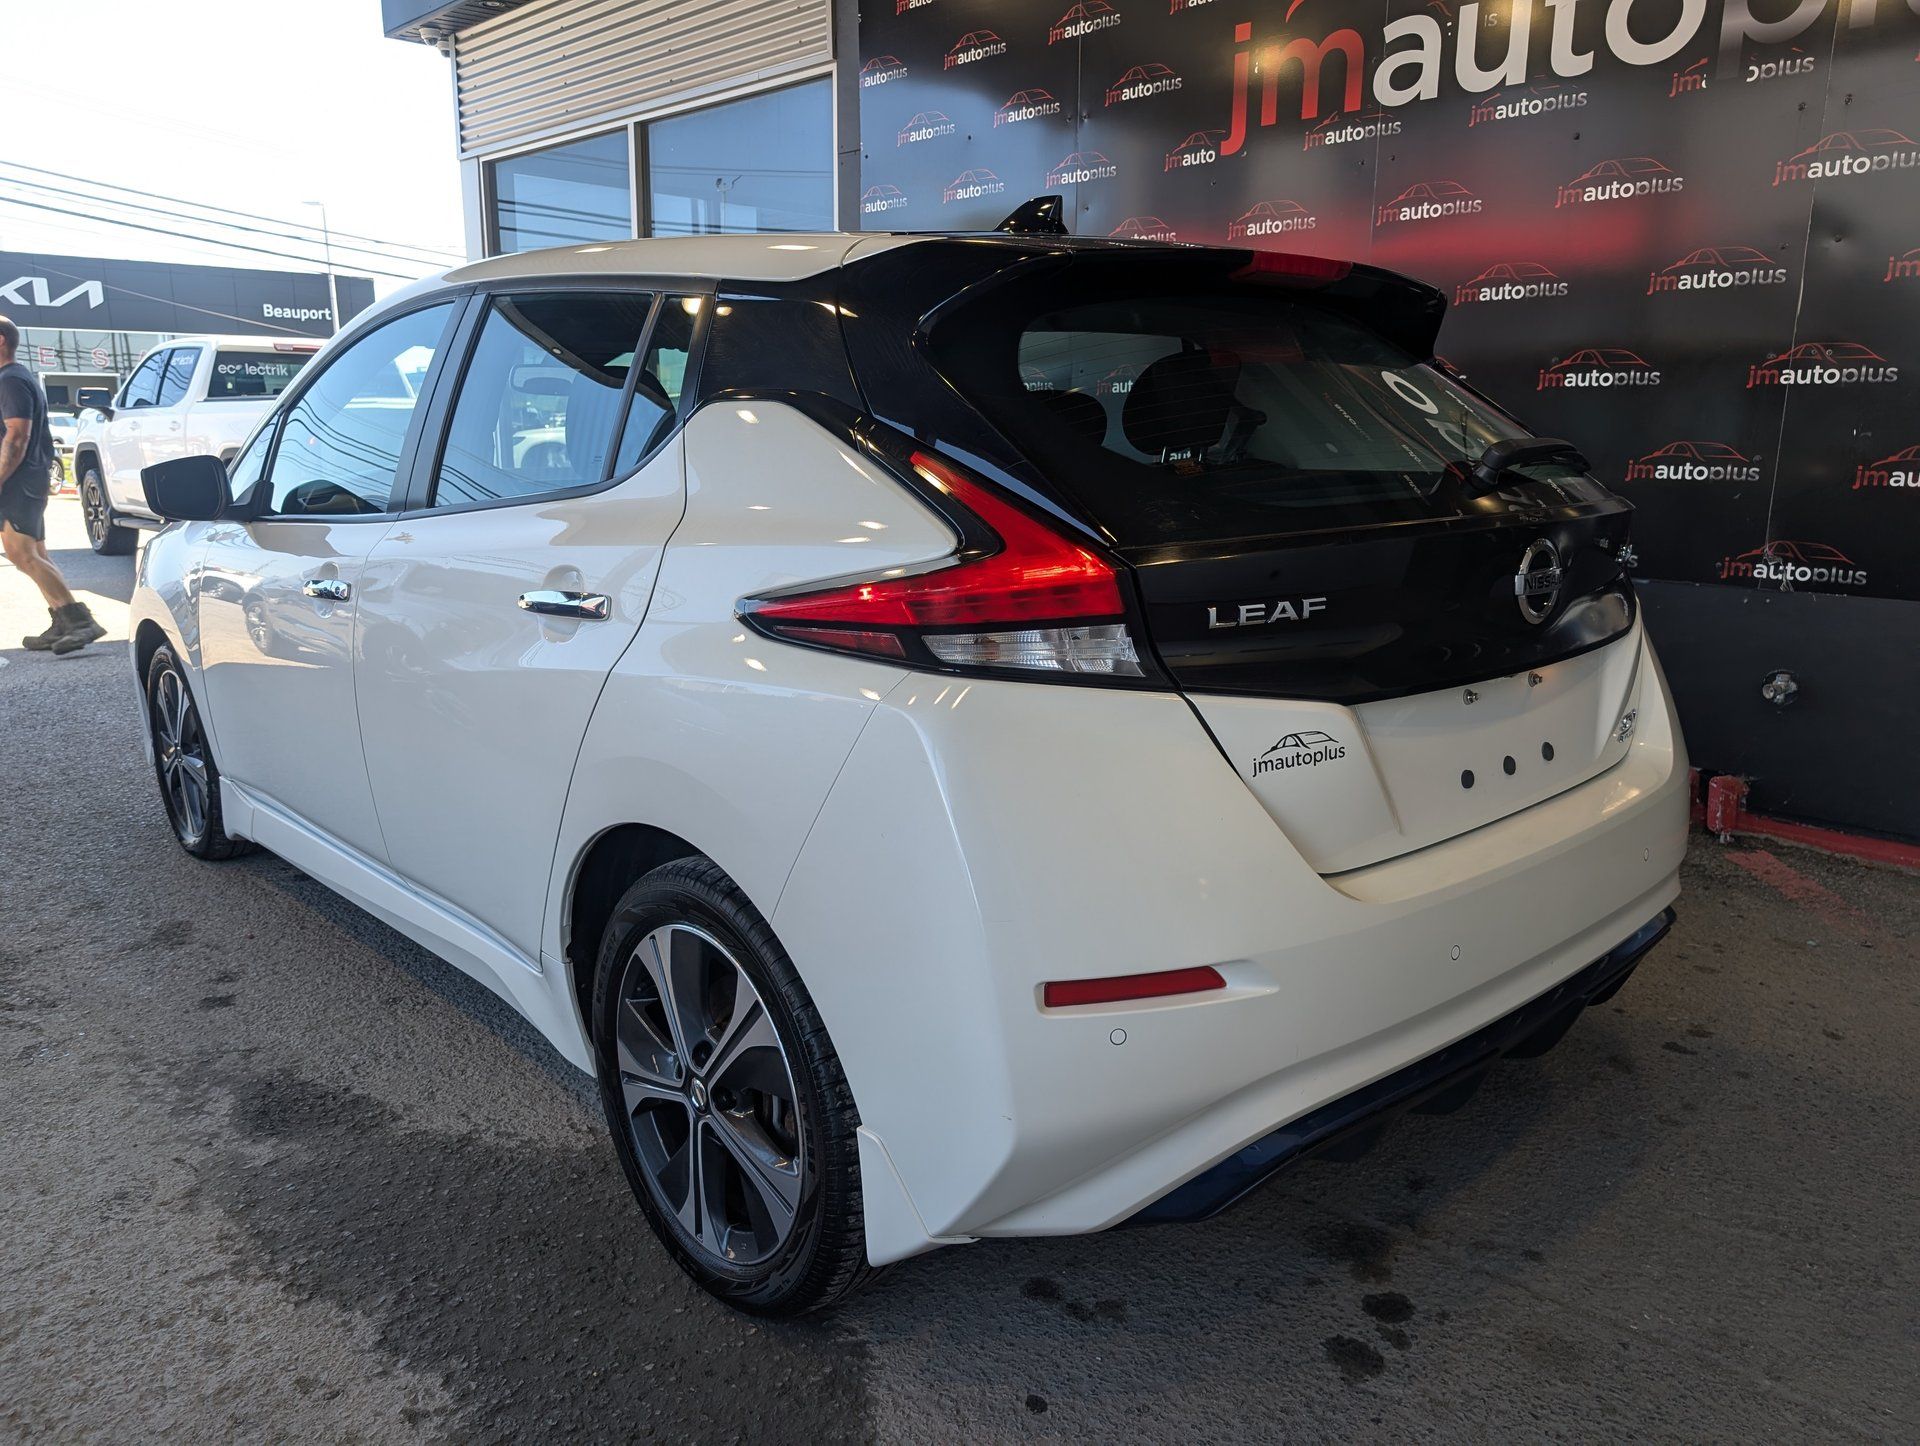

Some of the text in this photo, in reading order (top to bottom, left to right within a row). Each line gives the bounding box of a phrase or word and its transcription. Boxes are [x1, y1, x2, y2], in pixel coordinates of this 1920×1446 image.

[1048, 13, 1121, 45] jmautoplus
[944, 42, 1007, 71] jmautoplus
[1104, 77, 1183, 107] jmautoplus
[993, 101, 1061, 129] jmautoplus
[1468, 90, 1588, 128] jmautoplus
[897, 123, 955, 148] jmautoplus
[1303, 119, 1402, 151] jmautoplus
[1045, 164, 1117, 189] jmautoplus
[1772, 150, 1920, 187] jmautoplu
[943, 182, 1005, 204] jmautoplus
[1554, 176, 1684, 208] jmautoplus
[1376, 198, 1482, 226] jmautoplus
[1227, 215, 1316, 241] jmautoplus
[1454, 280, 1569, 306] jmautoplus
[1647, 266, 1787, 295] jmautoplus
[263, 303, 332, 321] Beauport
[1537, 369, 1661, 391] jmautoplus
[1746, 363, 1899, 389] jmautoplus
[1625, 459, 1760, 482] jmautoplus
[1720, 556, 1867, 586] jmautoplus
[1208, 597, 1327, 630] LEAF
[1252, 743, 1346, 778] jmautoplus
